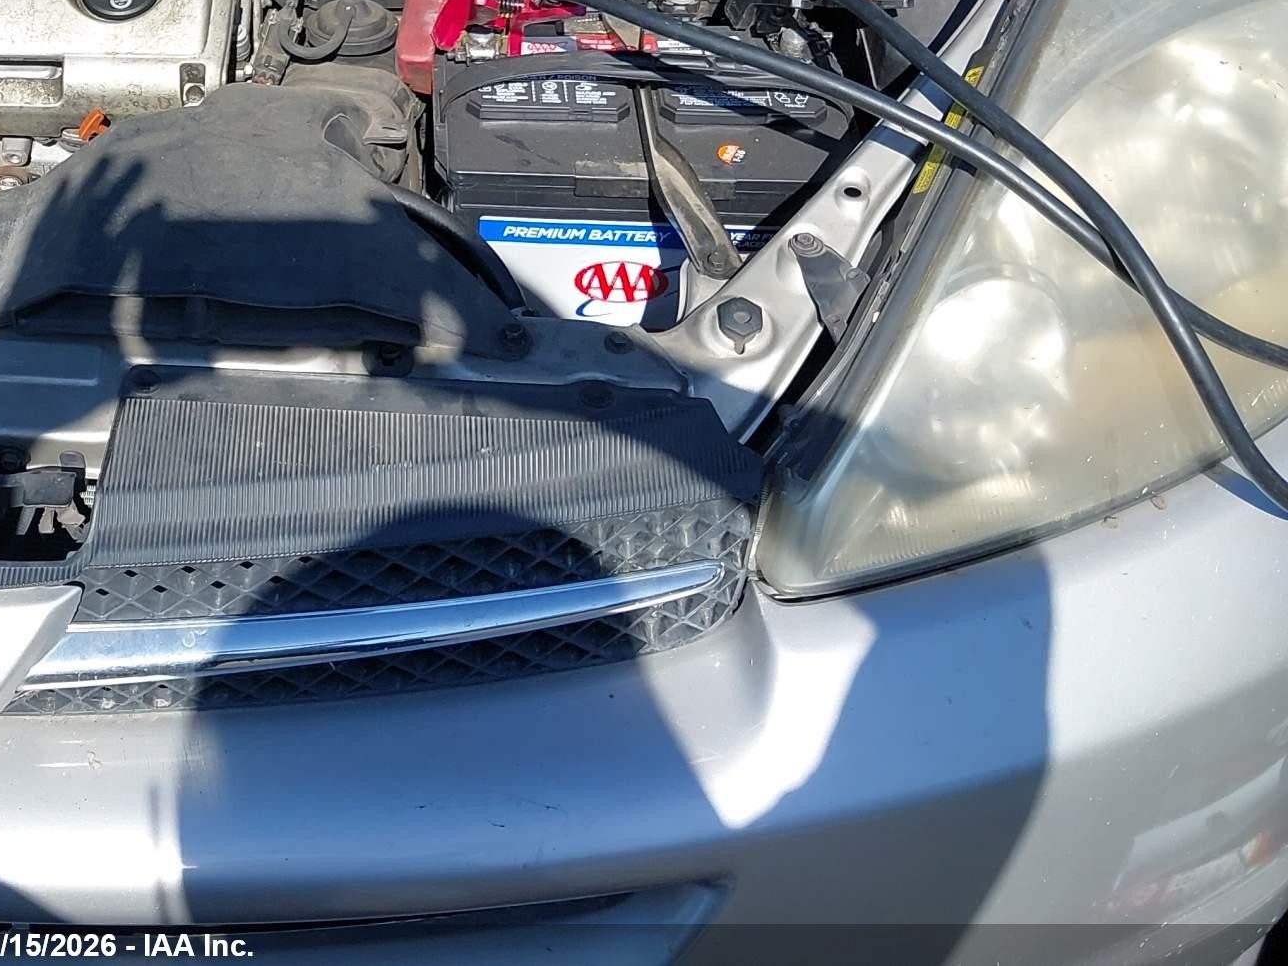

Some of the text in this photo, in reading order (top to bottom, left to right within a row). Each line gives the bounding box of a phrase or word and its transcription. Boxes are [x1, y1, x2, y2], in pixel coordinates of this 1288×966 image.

[503, 225, 671, 243] PREMIUM BATTERY
[575, 261, 668, 302] AAA
